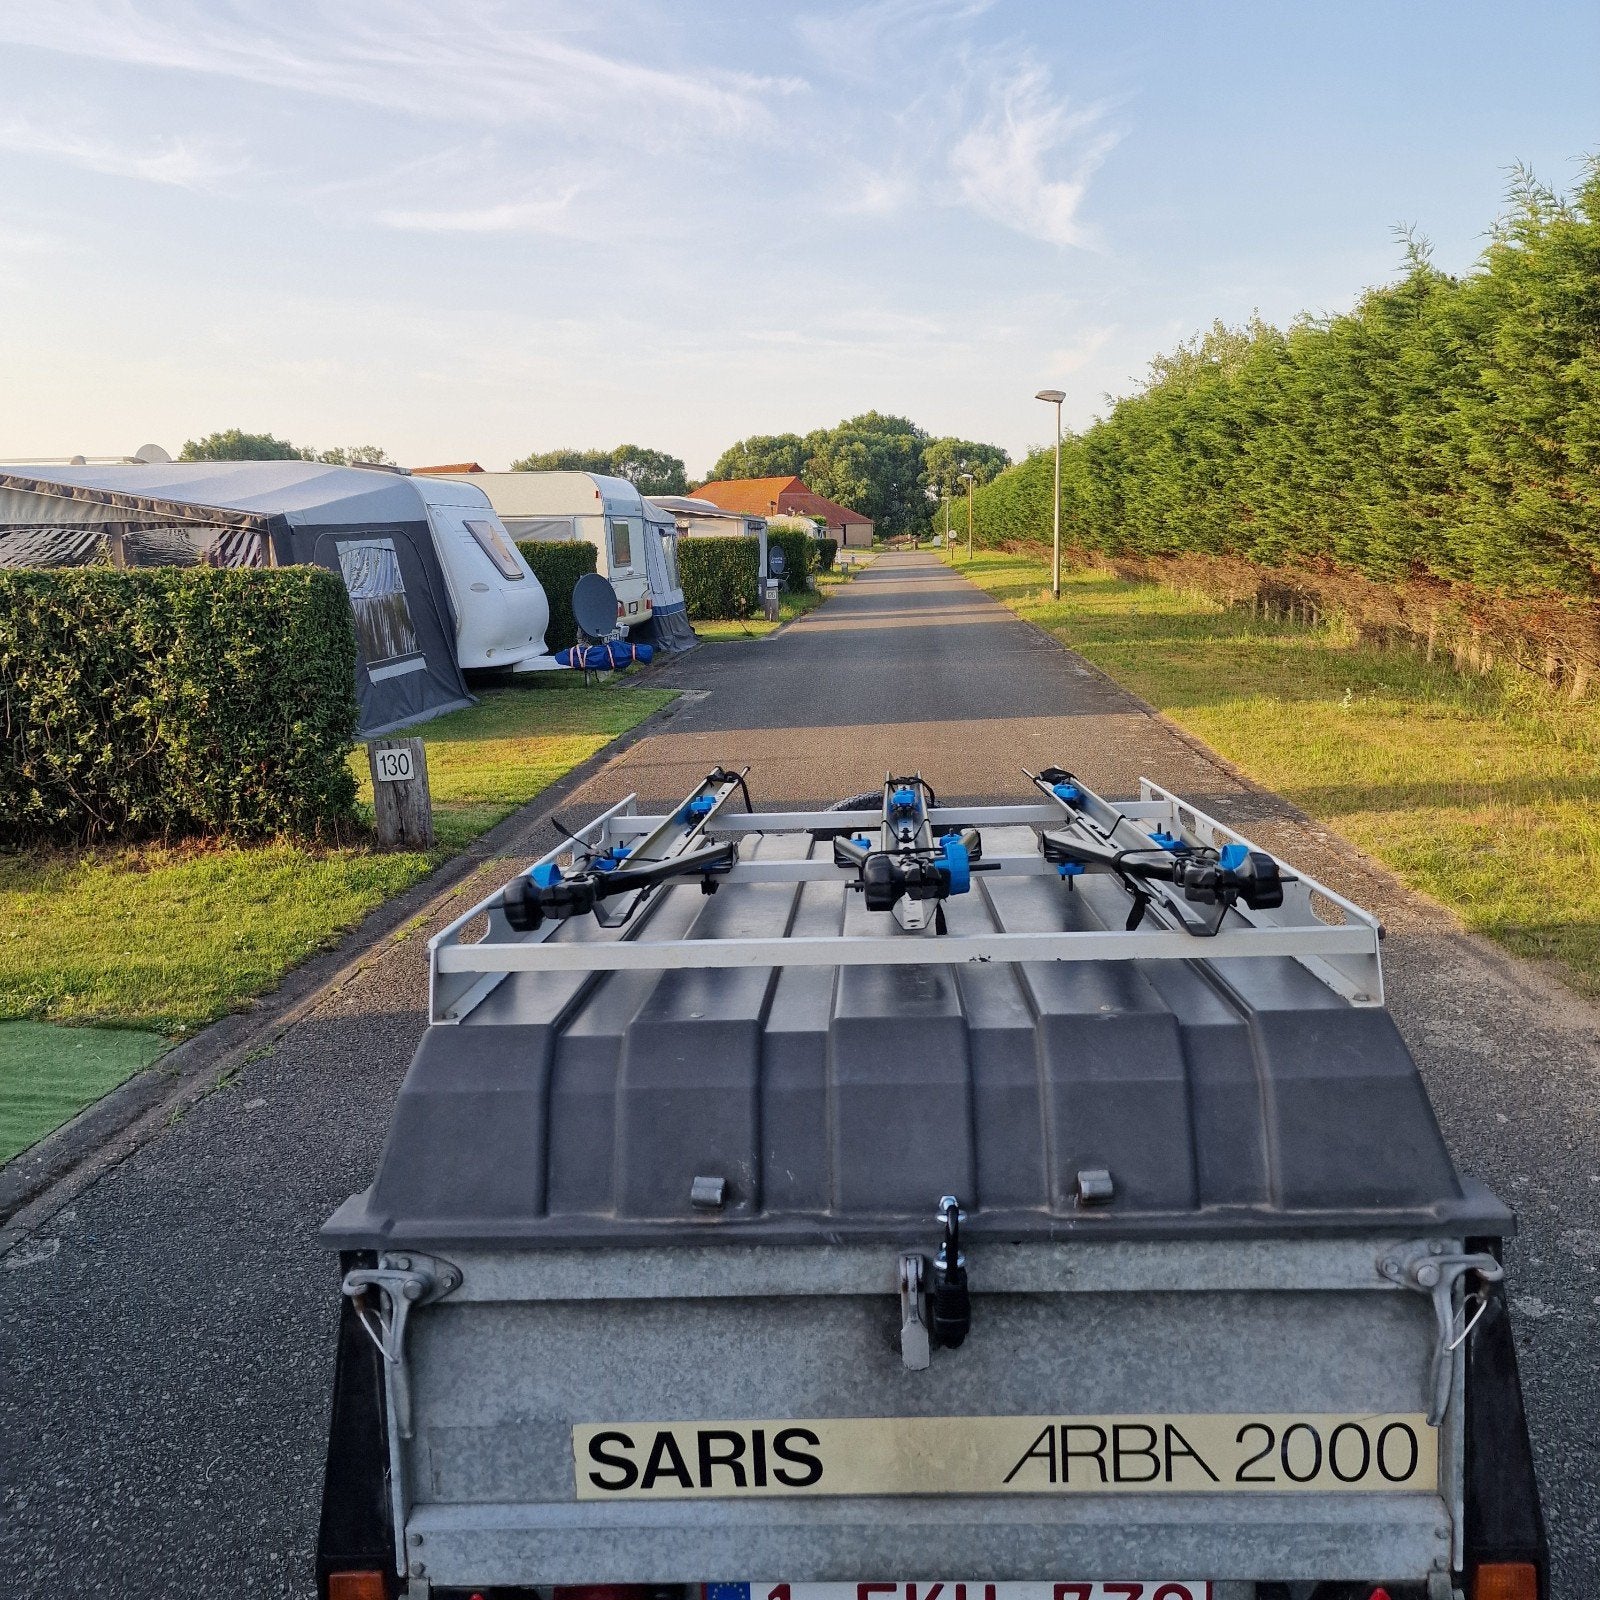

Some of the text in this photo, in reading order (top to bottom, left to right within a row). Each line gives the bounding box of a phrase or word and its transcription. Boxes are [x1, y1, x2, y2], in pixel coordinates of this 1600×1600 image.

[380, 753, 410, 776] 130
[588, 1422, 1419, 1491] SARIS ARBA 2000
